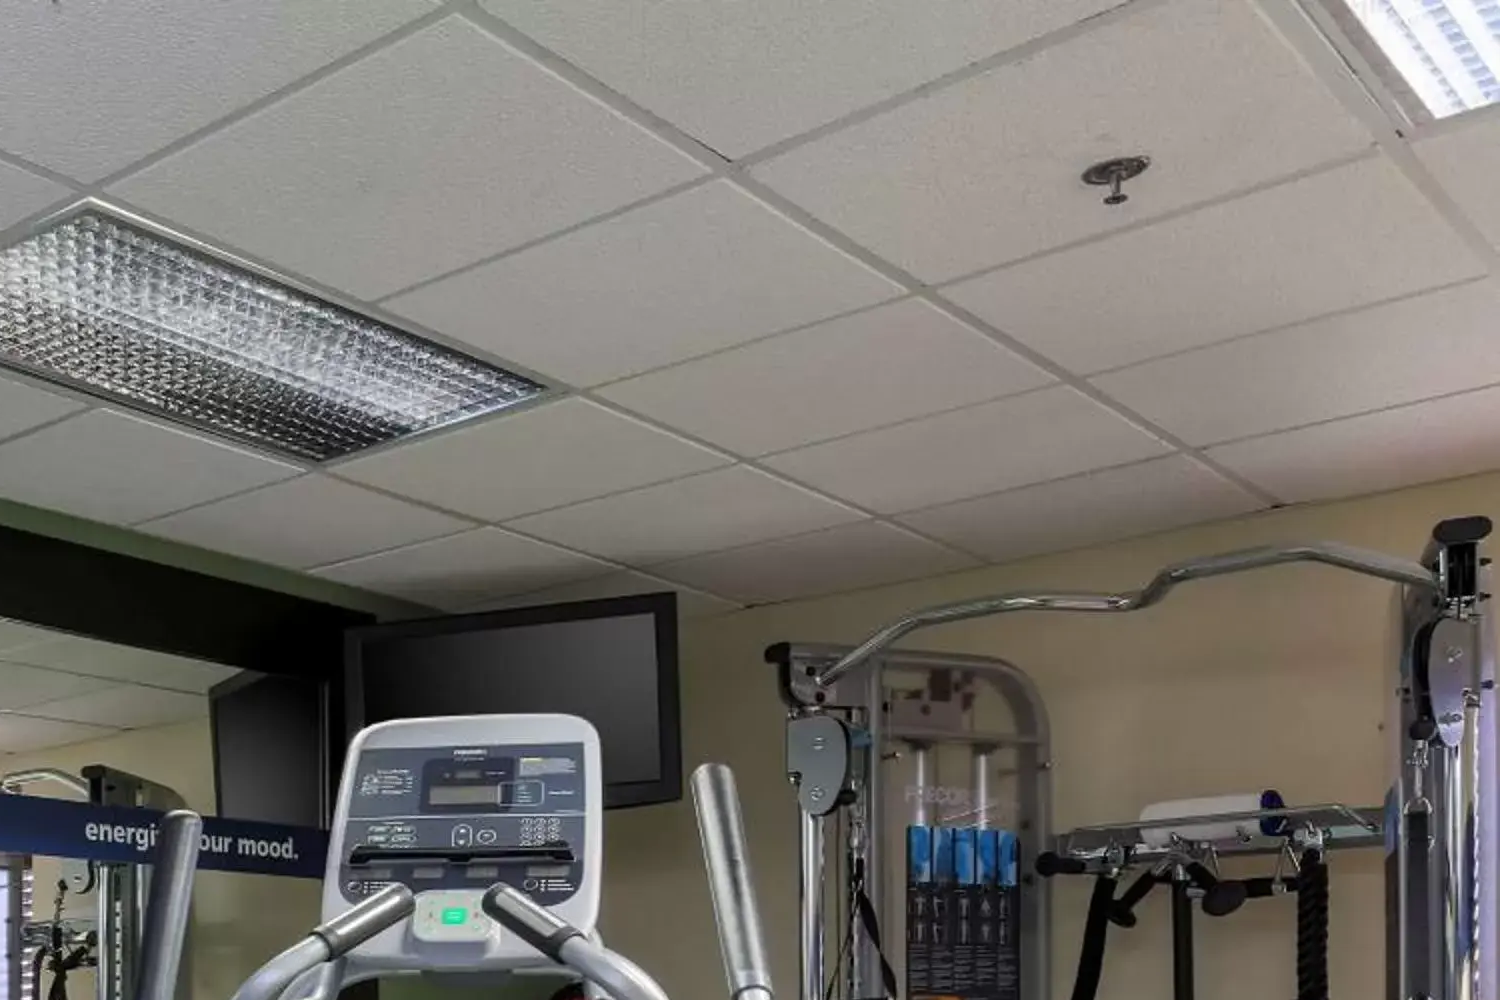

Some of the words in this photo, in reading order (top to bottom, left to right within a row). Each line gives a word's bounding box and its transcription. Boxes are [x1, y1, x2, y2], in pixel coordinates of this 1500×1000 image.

[85, 821, 159, 850] energi
[199, 833, 233, 853] our
[237, 837, 299, 860] mood.
